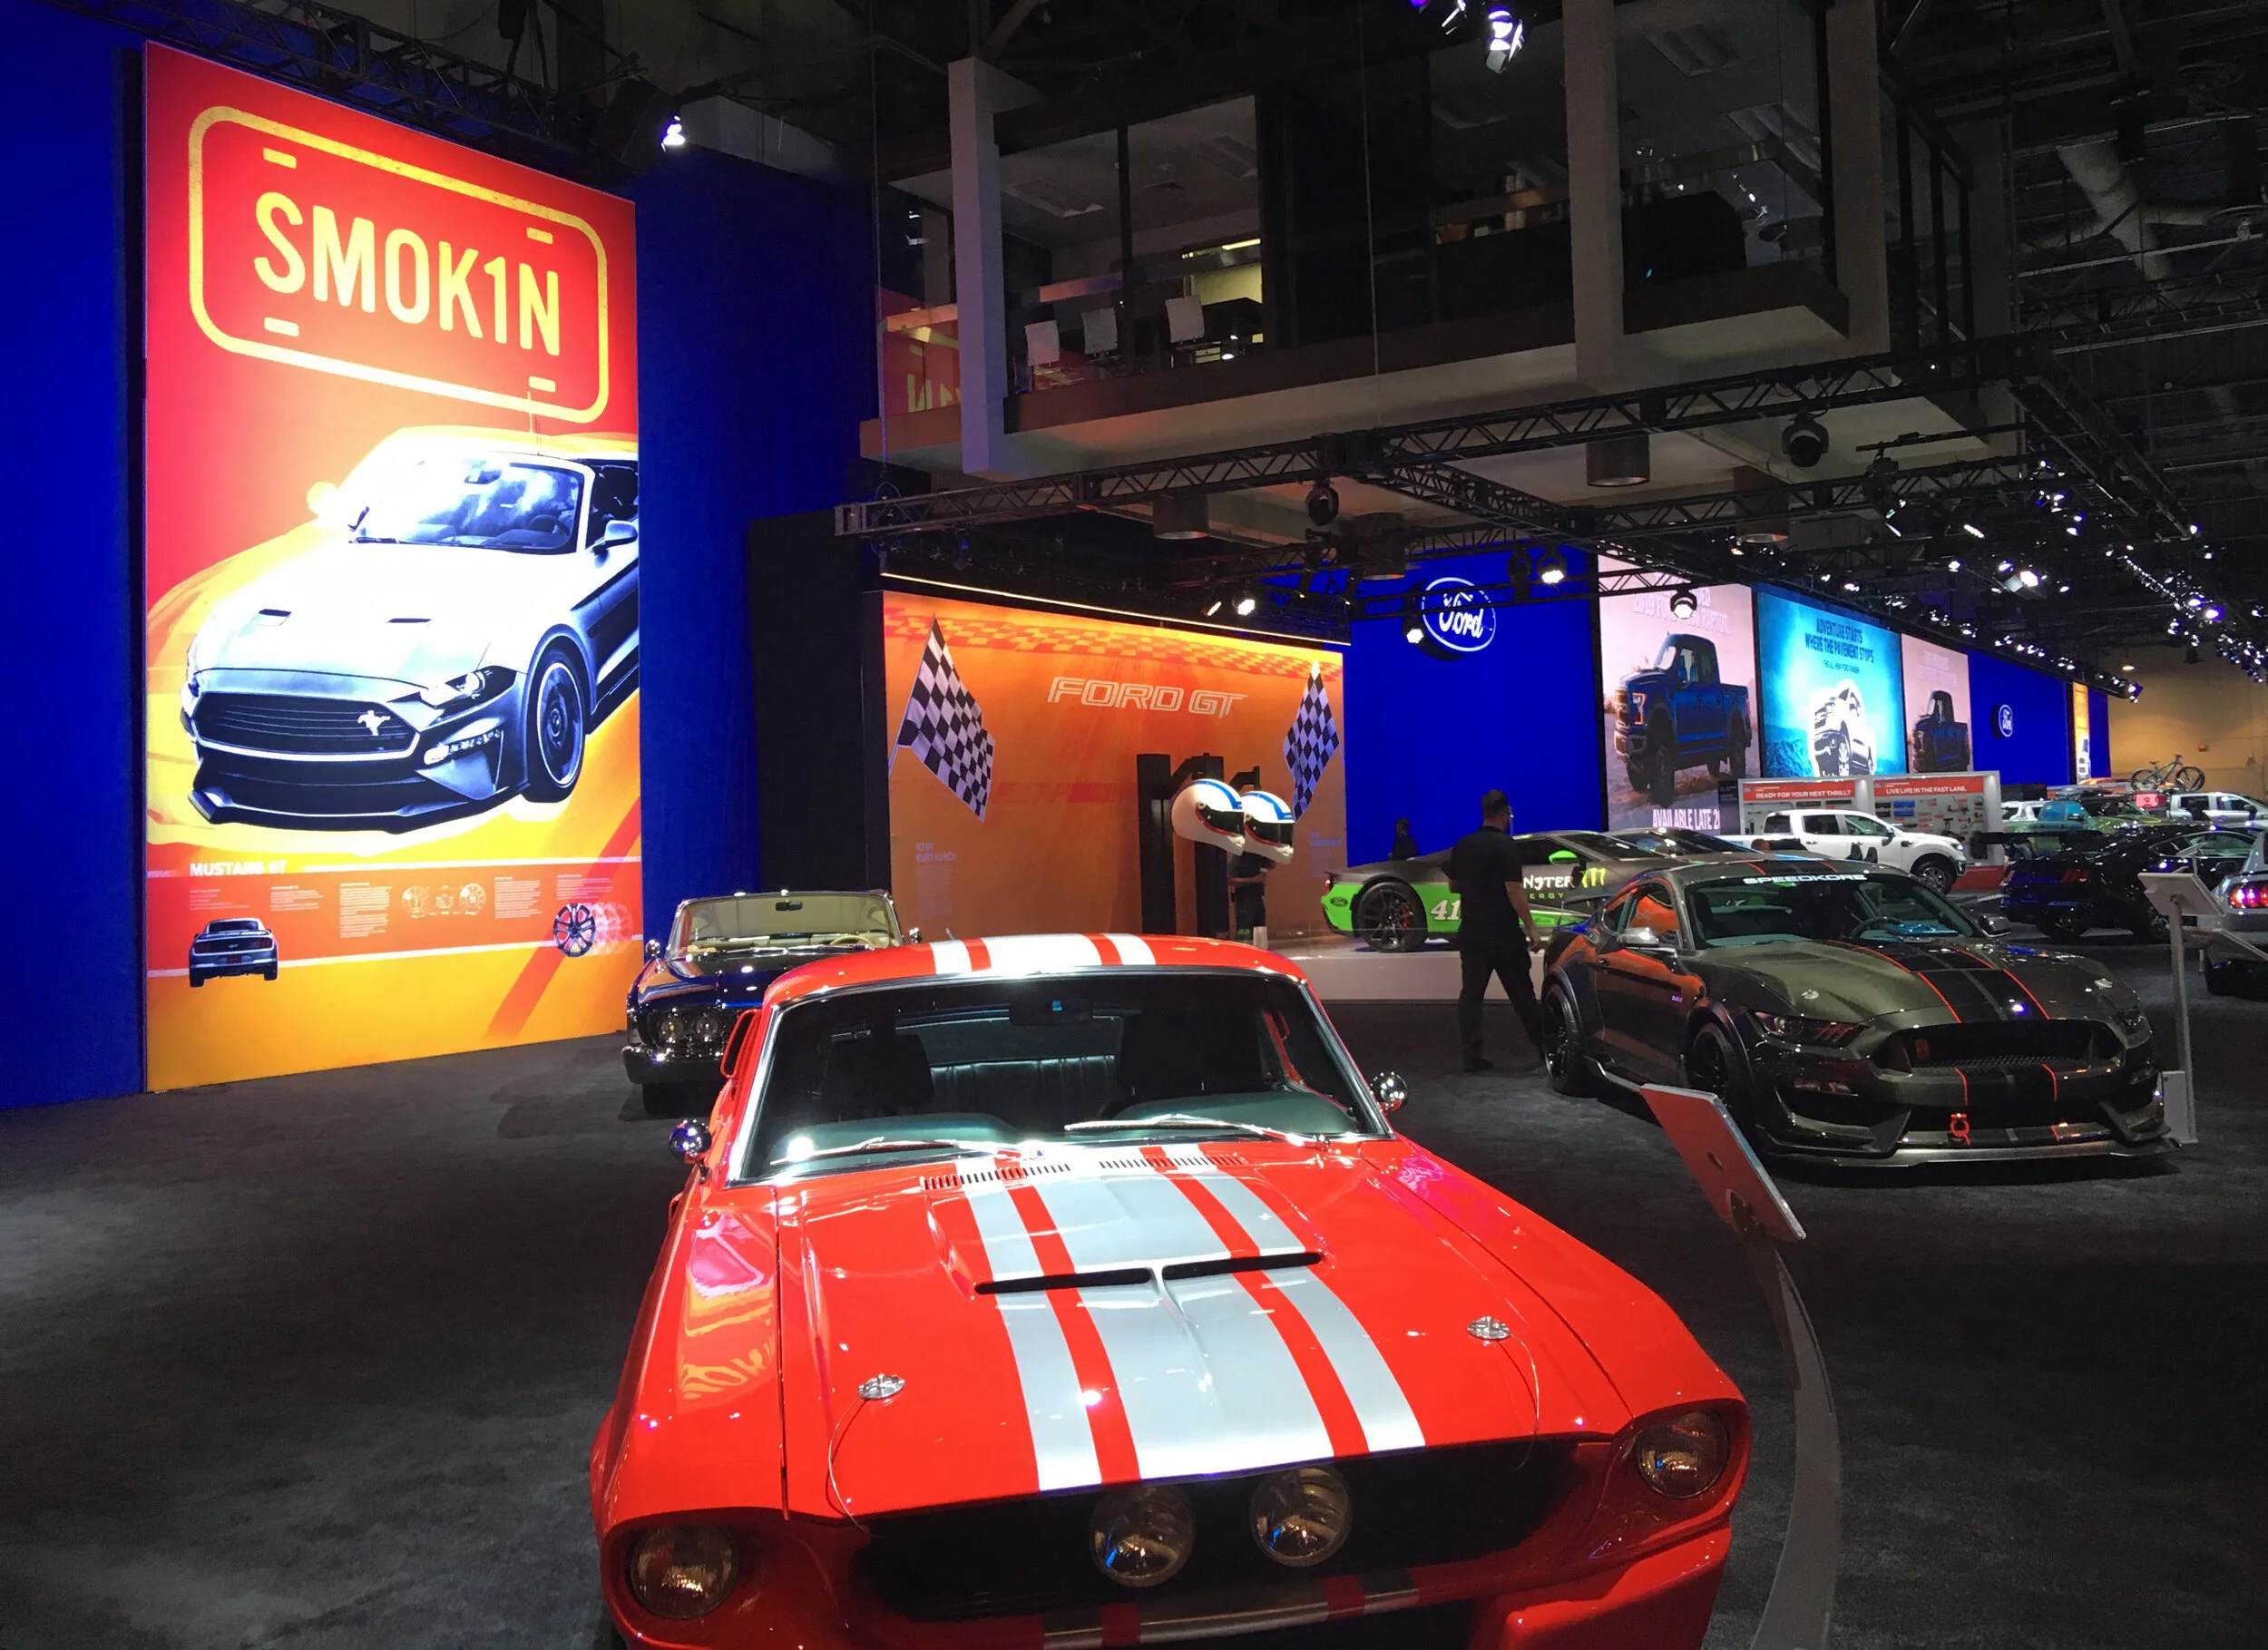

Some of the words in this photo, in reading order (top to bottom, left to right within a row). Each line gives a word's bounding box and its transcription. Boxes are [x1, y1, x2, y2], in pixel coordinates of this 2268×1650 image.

[254, 191, 561, 356] SMOK1N
[1439, 591, 1483, 639] Ford
[1804, 632, 1823, 652] WHERE
[1823, 637, 1833, 655] THE
[1859, 646, 1874, 664] STOPS
[1047, 676, 1184, 712] FORD
[1188, 688, 1249, 719] GT
[1653, 808, 1693, 829] AVAILABLE
[1694, 809, 1713, 830] LATE
[190, 863, 264, 876] MUSTANG
[1743, 874, 1868, 885] SPEEDKORE
[1431, 899, 1461, 921] 41
